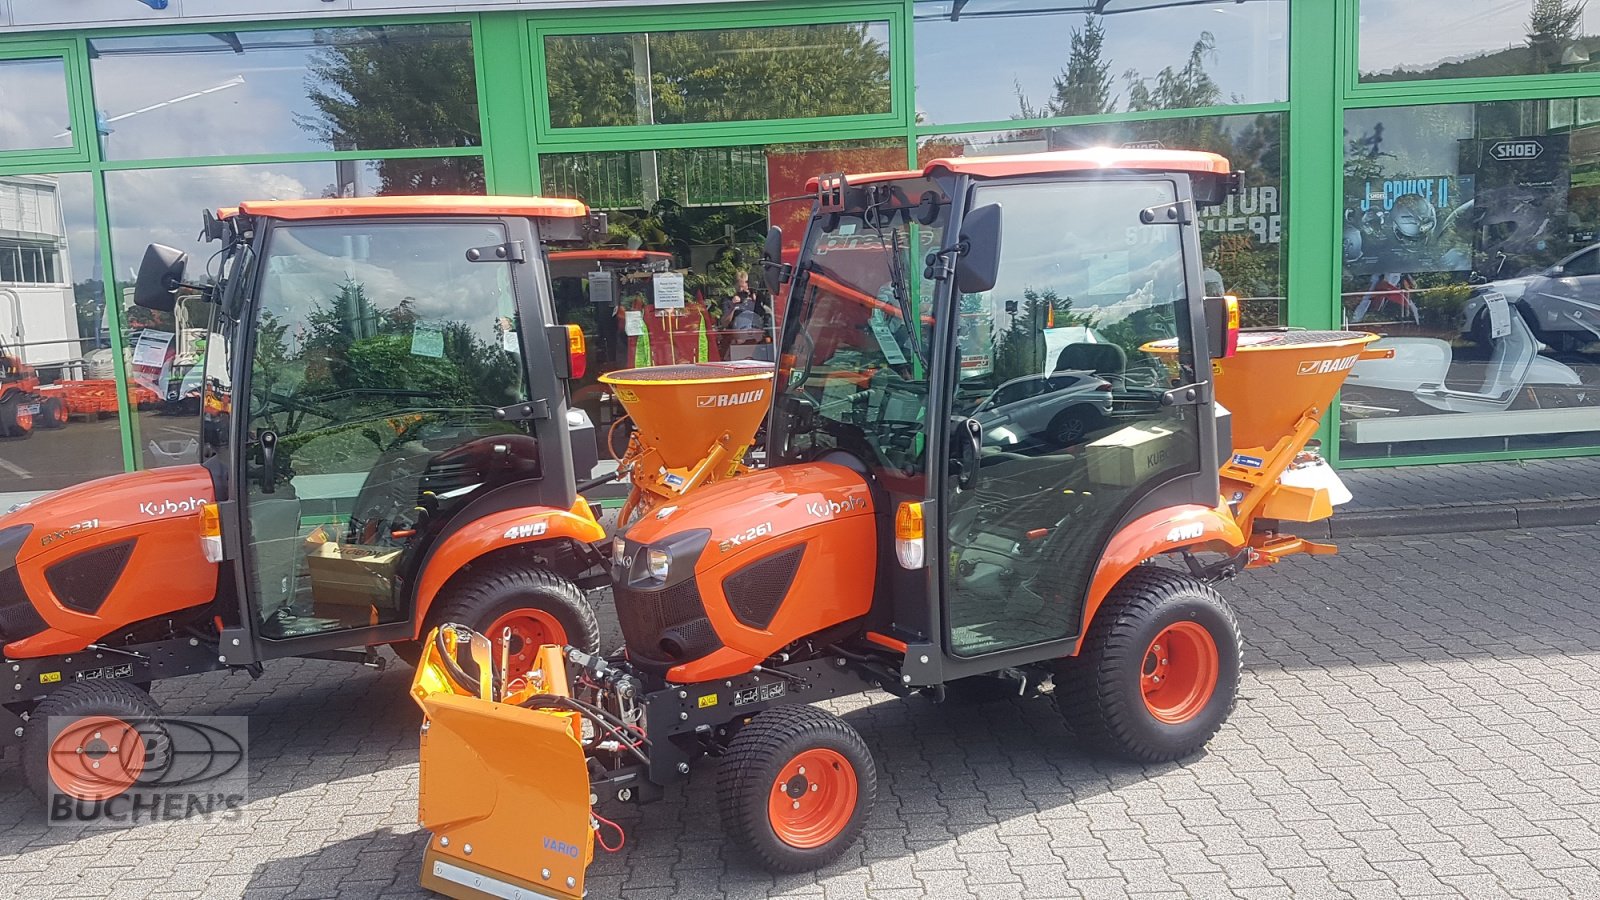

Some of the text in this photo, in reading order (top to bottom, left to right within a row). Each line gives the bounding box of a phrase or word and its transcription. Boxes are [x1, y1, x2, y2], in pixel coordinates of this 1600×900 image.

[1497, 144, 1537, 158] SHOEI
[717, 389, 764, 407] RAUCH
[806, 496, 867, 517] Kubota
[41, 518, 100, 547] BX-231
[503, 522, 547, 540] 4WD
[1166, 521, 1205, 543] 4WD
[543, 836, 579, 858] VARIO
